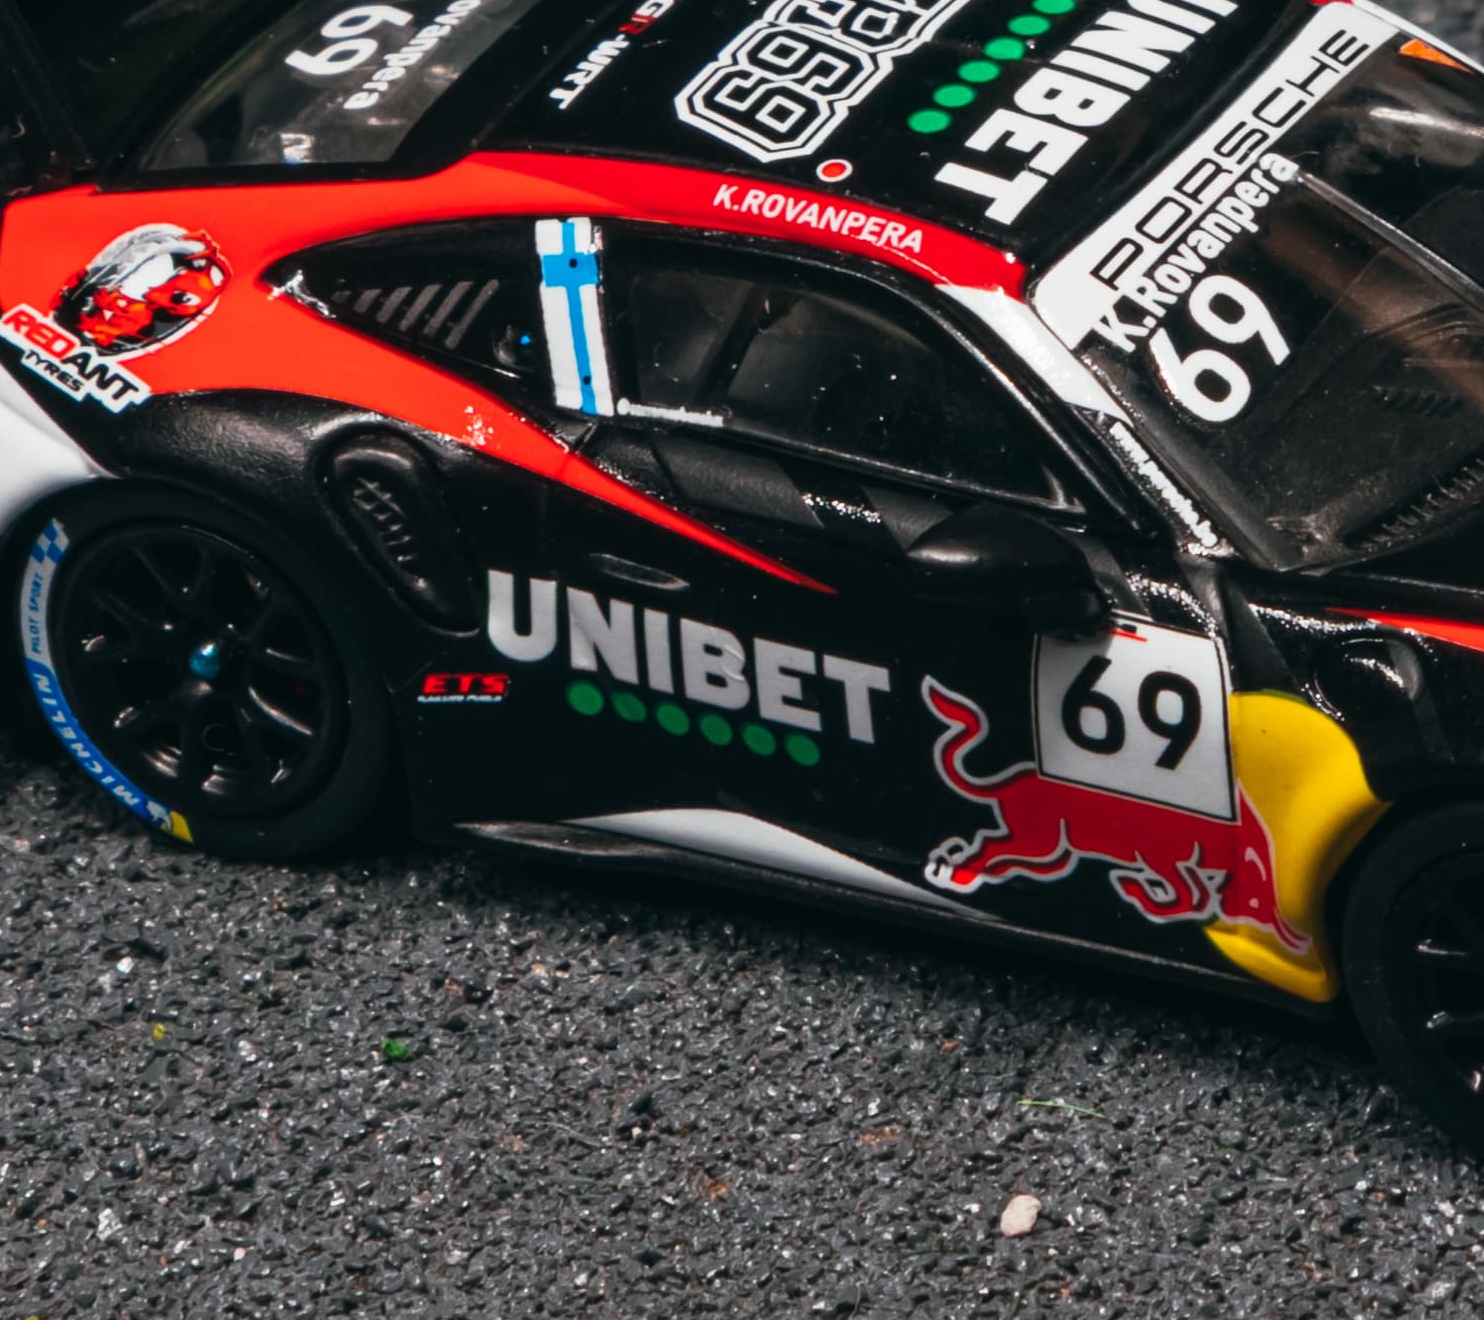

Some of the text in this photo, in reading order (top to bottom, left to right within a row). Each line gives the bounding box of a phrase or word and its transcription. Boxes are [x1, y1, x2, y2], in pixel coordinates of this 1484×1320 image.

[284, 4, 415, 76] 69
[712, 184, 923, 254] K.ROVANPERA
[1089, 28, 1371, 291] PORSCHE
[1092, 152, 1300, 353] K.Rovanpera
[24, 349, 86, 393] TYRES
[1148, 275, 1291, 422] 69
[422, 672, 509, 694] ETS
[486, 568, 890, 744] UNIBET
[1060, 654, 1203, 771] 69
[32, 672, 141, 806] MICHELIN
